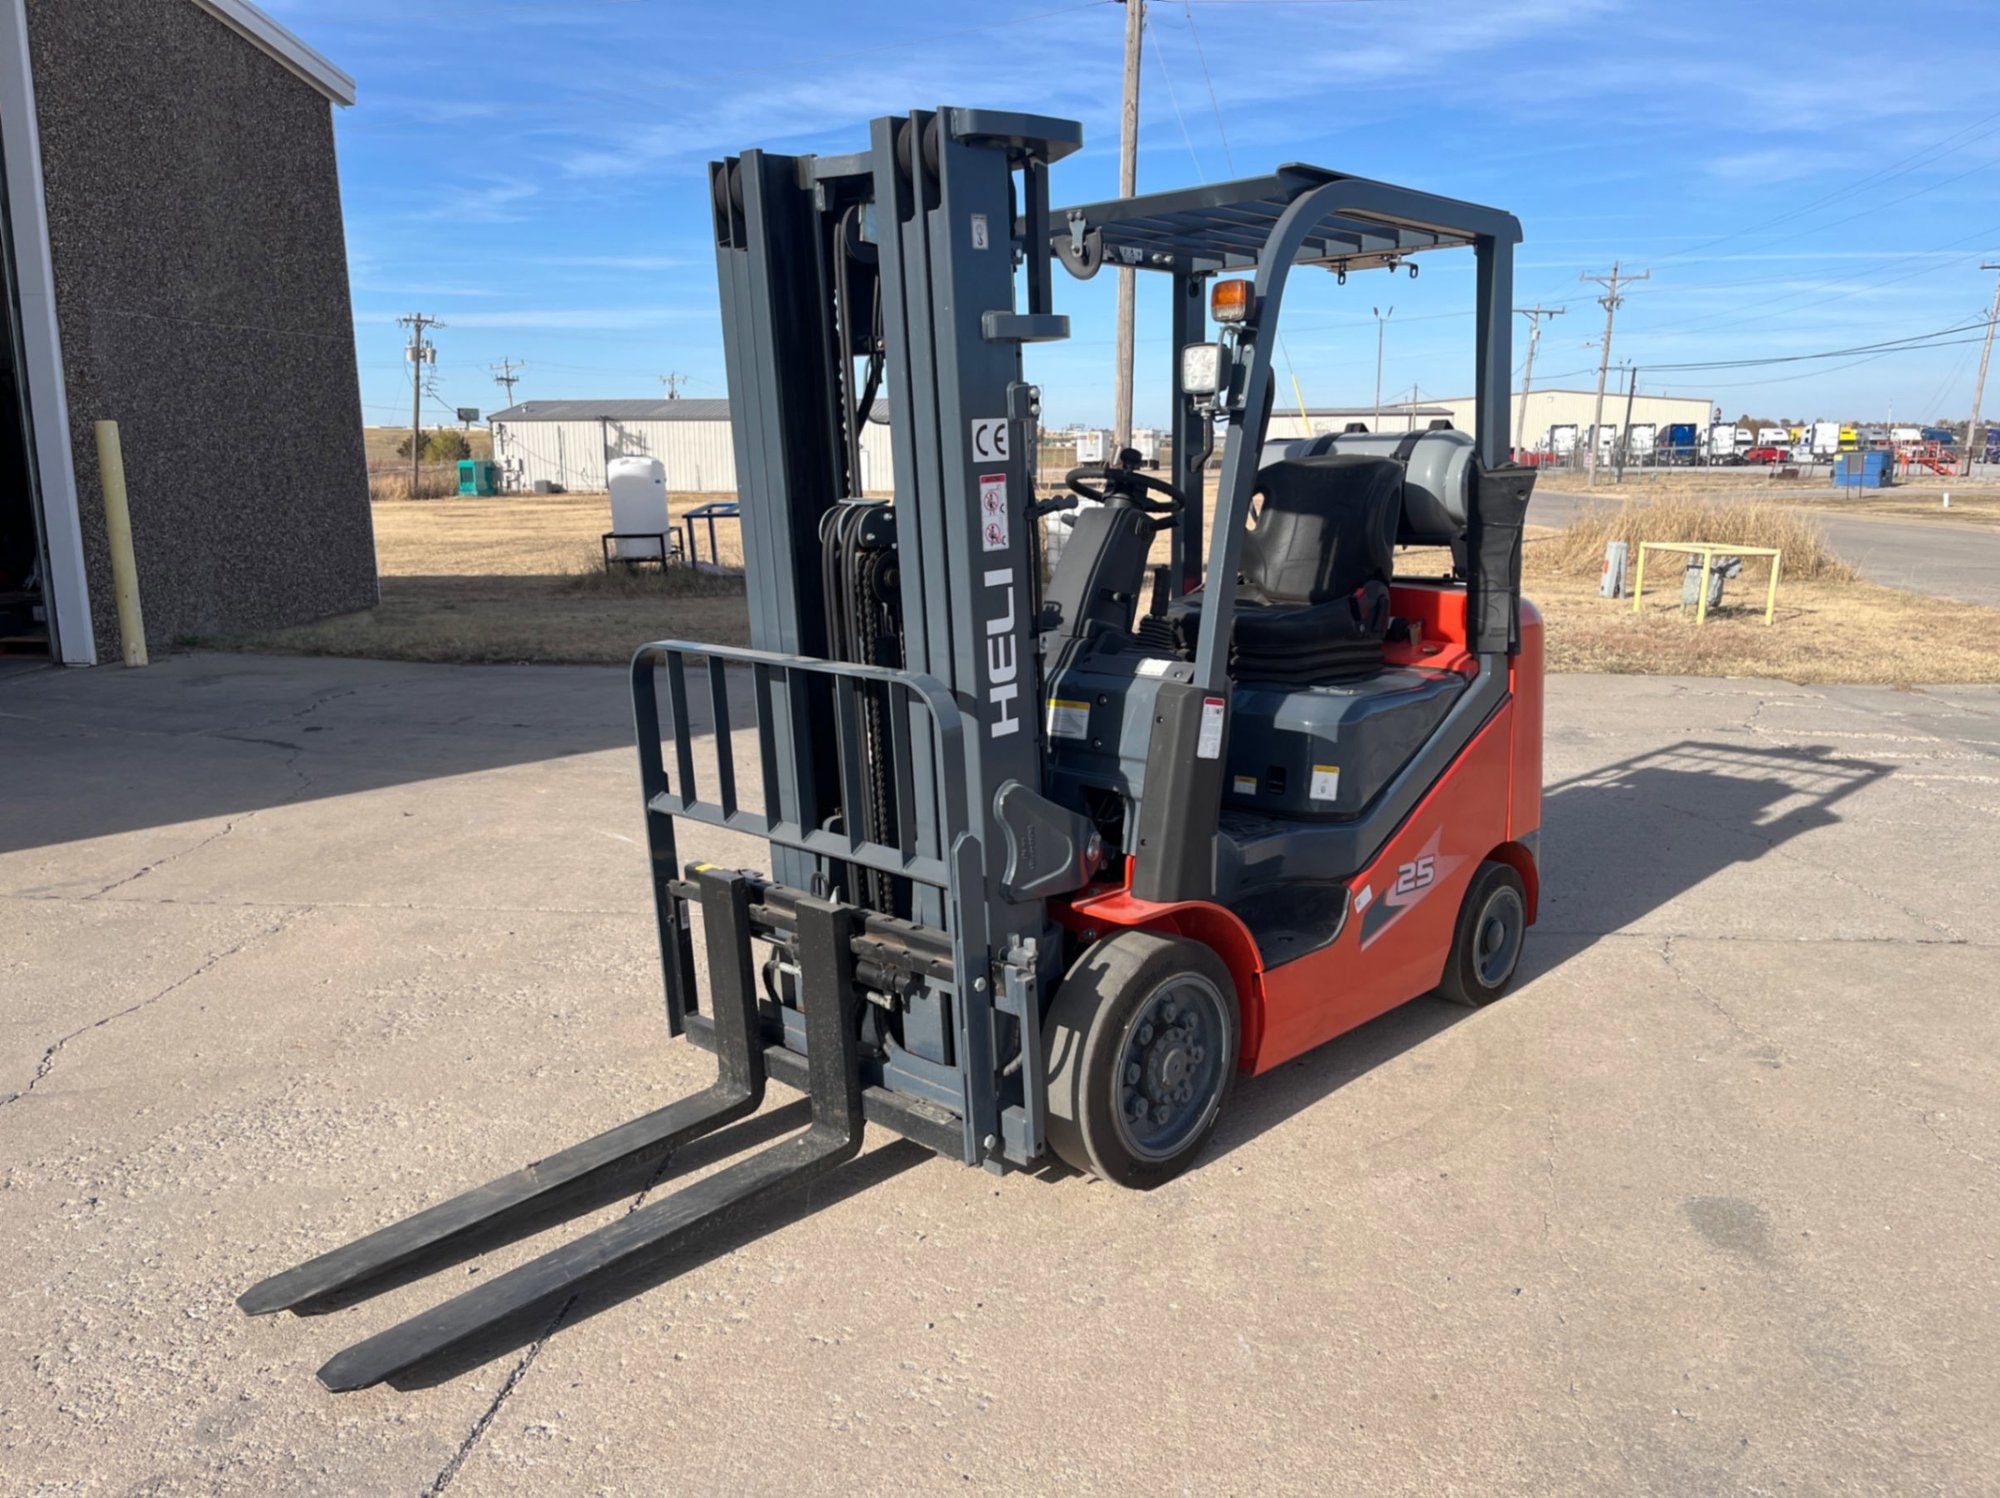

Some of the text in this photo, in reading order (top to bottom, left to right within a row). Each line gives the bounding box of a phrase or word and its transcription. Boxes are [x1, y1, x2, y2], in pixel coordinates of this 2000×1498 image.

[976, 423, 1006, 456] CE
[984, 567, 1020, 738] HELI
[1396, 855, 1435, 895] 25
